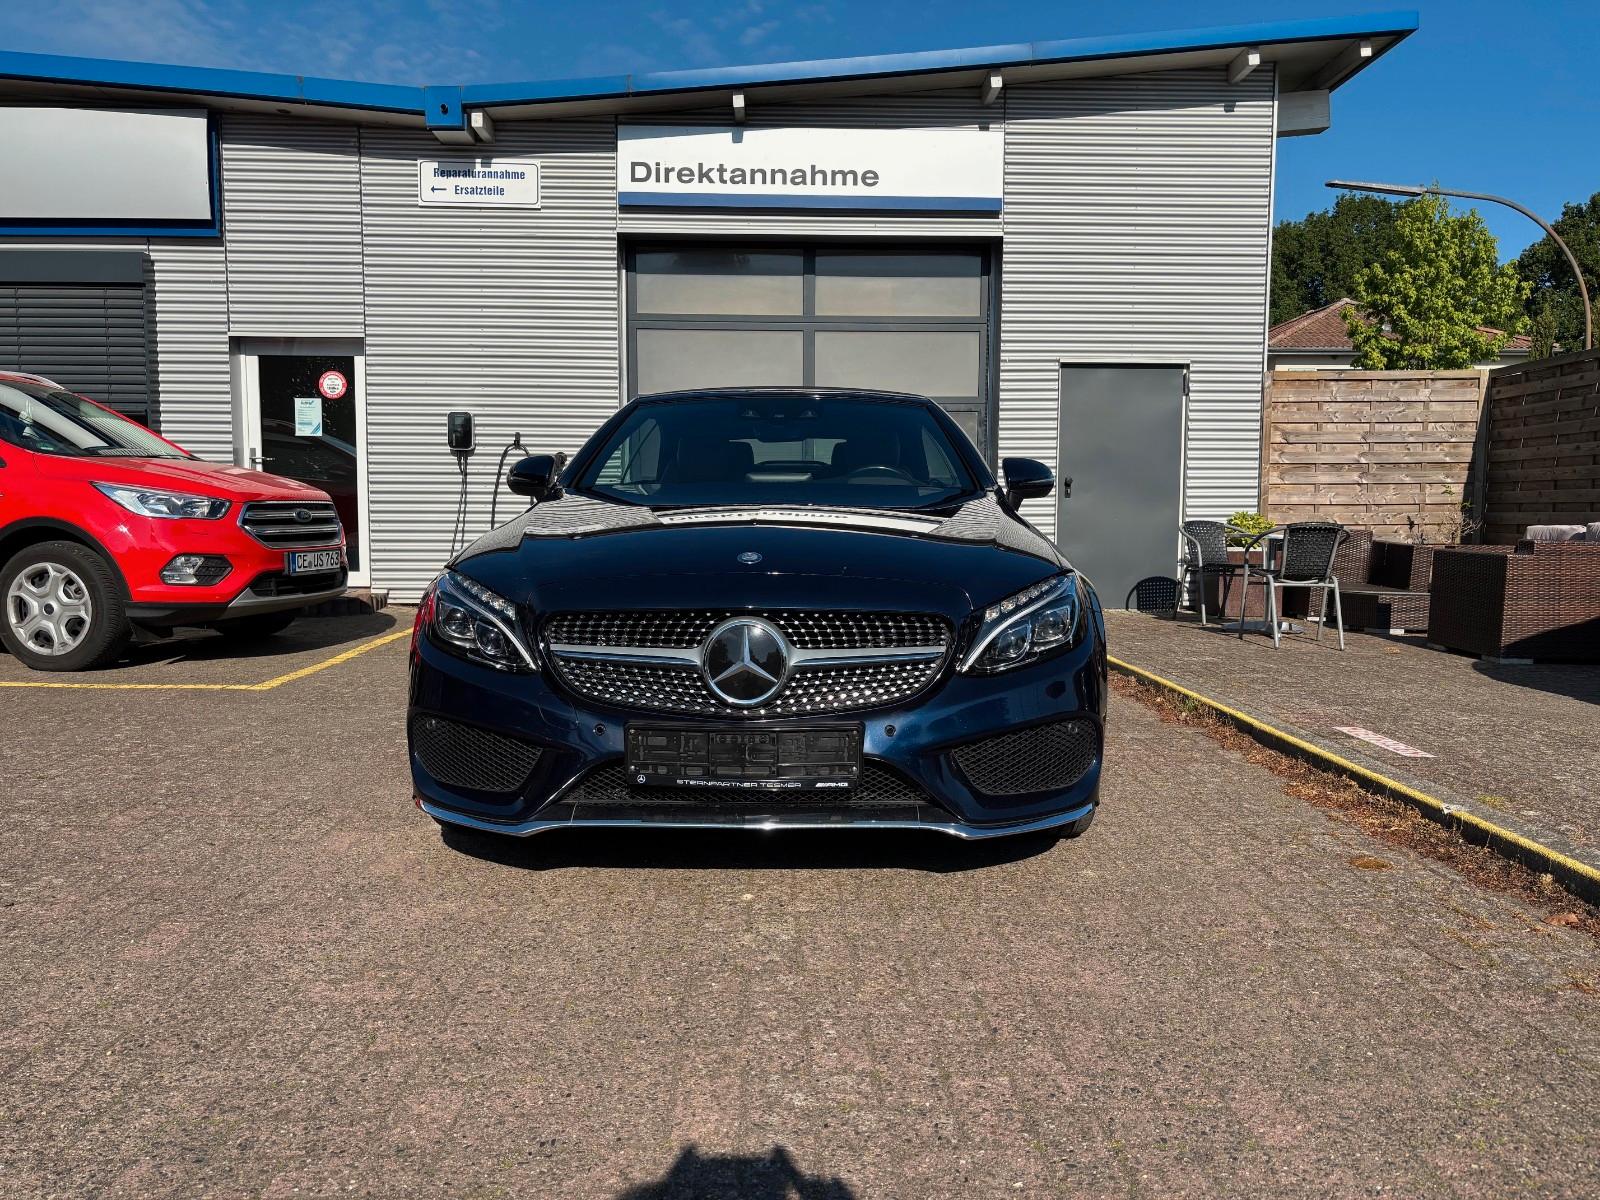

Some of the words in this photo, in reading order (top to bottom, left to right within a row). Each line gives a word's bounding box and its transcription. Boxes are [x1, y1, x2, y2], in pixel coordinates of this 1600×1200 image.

[433, 167, 526, 180] Reparaturannahme
[630, 161, 880, 187] Direktannahme
[454, 184, 505, 196] Ersatzteile
[297, 554, 309, 569] CE
[313, 553, 324, 568] US
[325, 551, 340, 566] 763
